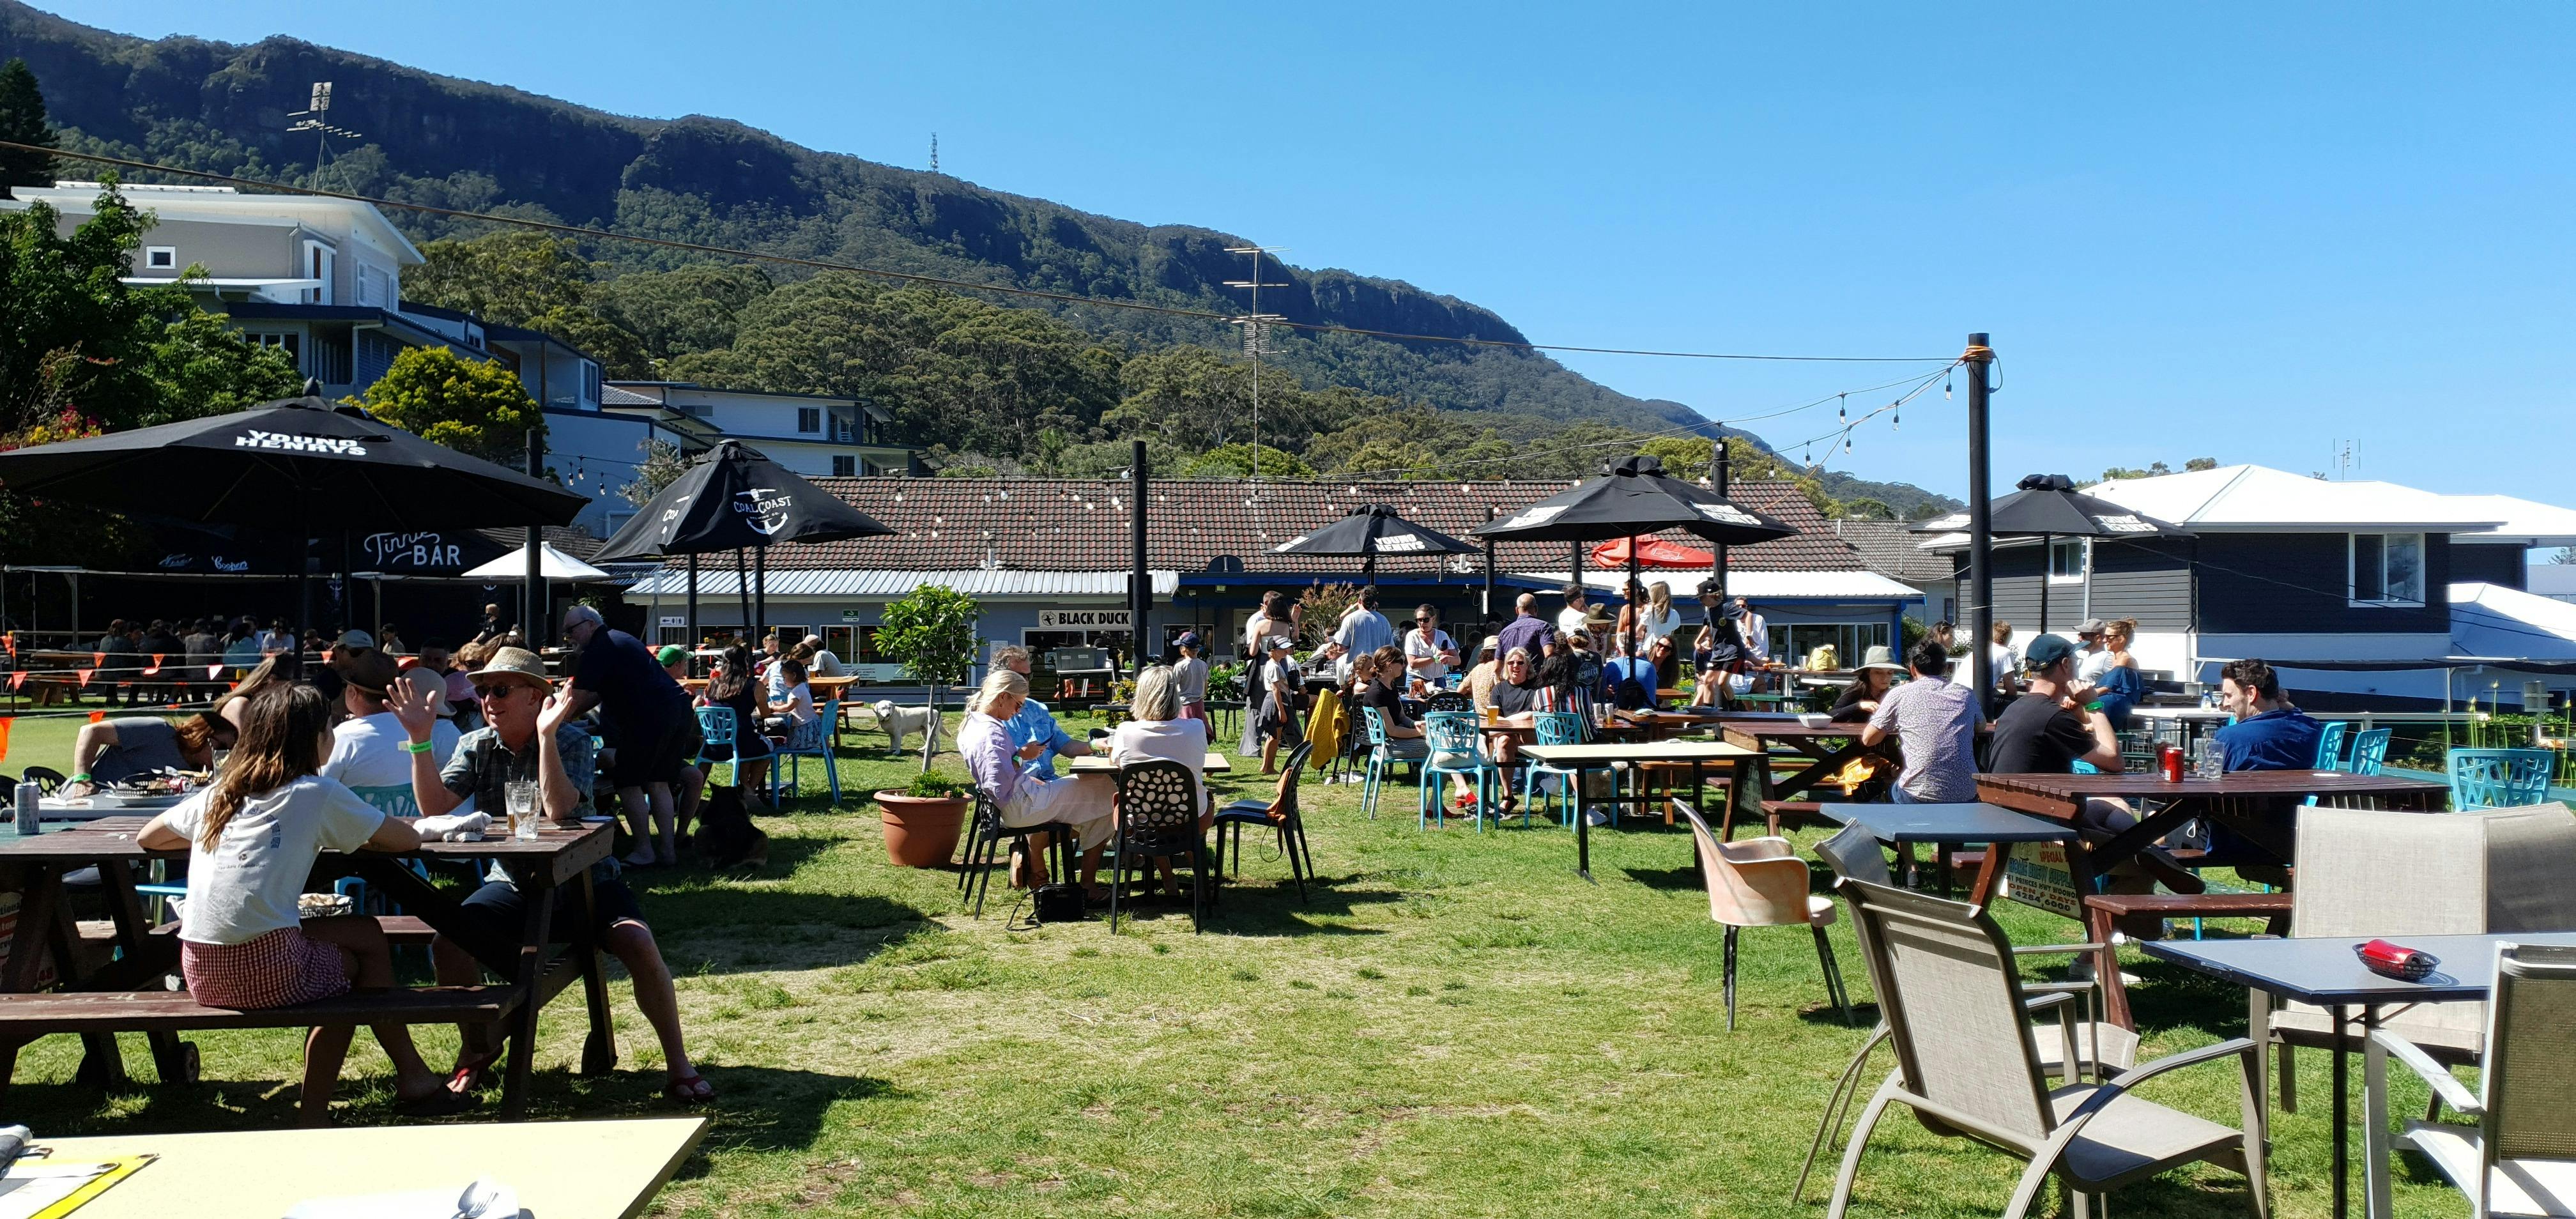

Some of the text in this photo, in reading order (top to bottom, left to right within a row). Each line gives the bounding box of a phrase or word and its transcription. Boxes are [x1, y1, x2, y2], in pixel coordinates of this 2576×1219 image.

[234, 436, 367, 456] HENRYS
[734, 496, 792, 514] COAL COAST
[662, 509, 679, 522] COA
[413, 544, 461, 566] BAR
[1058, 612, 1130, 625] BLACK DUCK
[2009, 883, 2036, 894] OPEN
[2049, 894, 2077, 906] DAYS
[2016, 877, 2037, 888] PRINCES
[2053, 887, 2077, 899] WOONO
[2044, 898, 2071, 912] 6000
